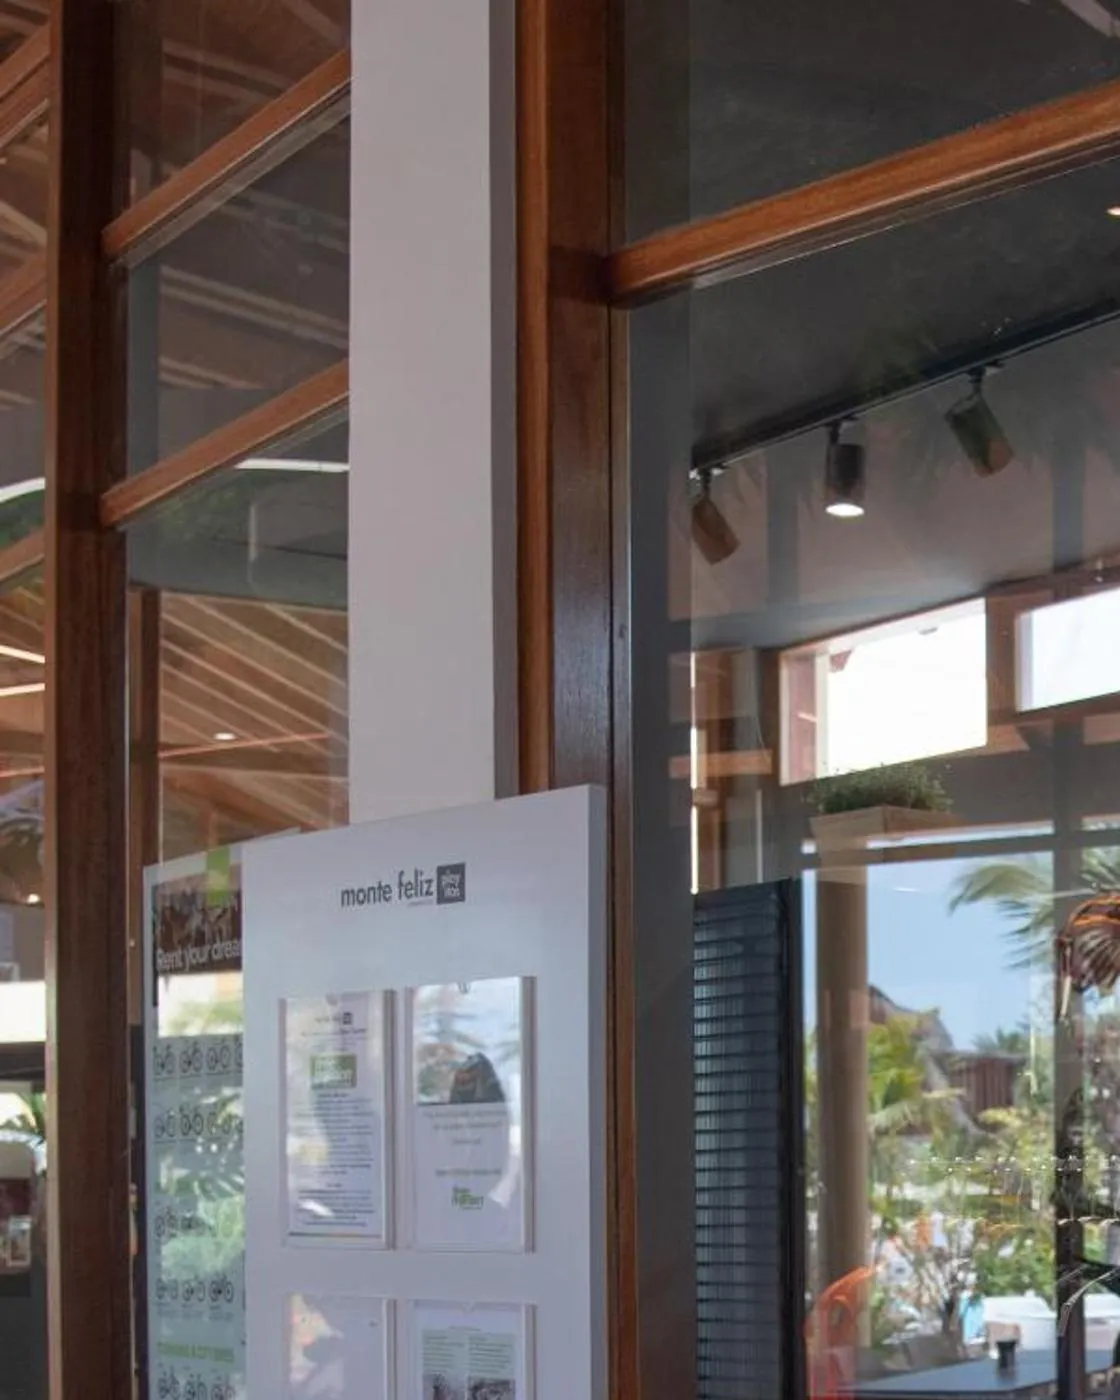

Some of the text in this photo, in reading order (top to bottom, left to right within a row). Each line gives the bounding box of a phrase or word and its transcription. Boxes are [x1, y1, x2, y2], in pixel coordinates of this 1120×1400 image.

[341, 867, 434, 907] monte feliz
[184, 943, 212, 972] your
